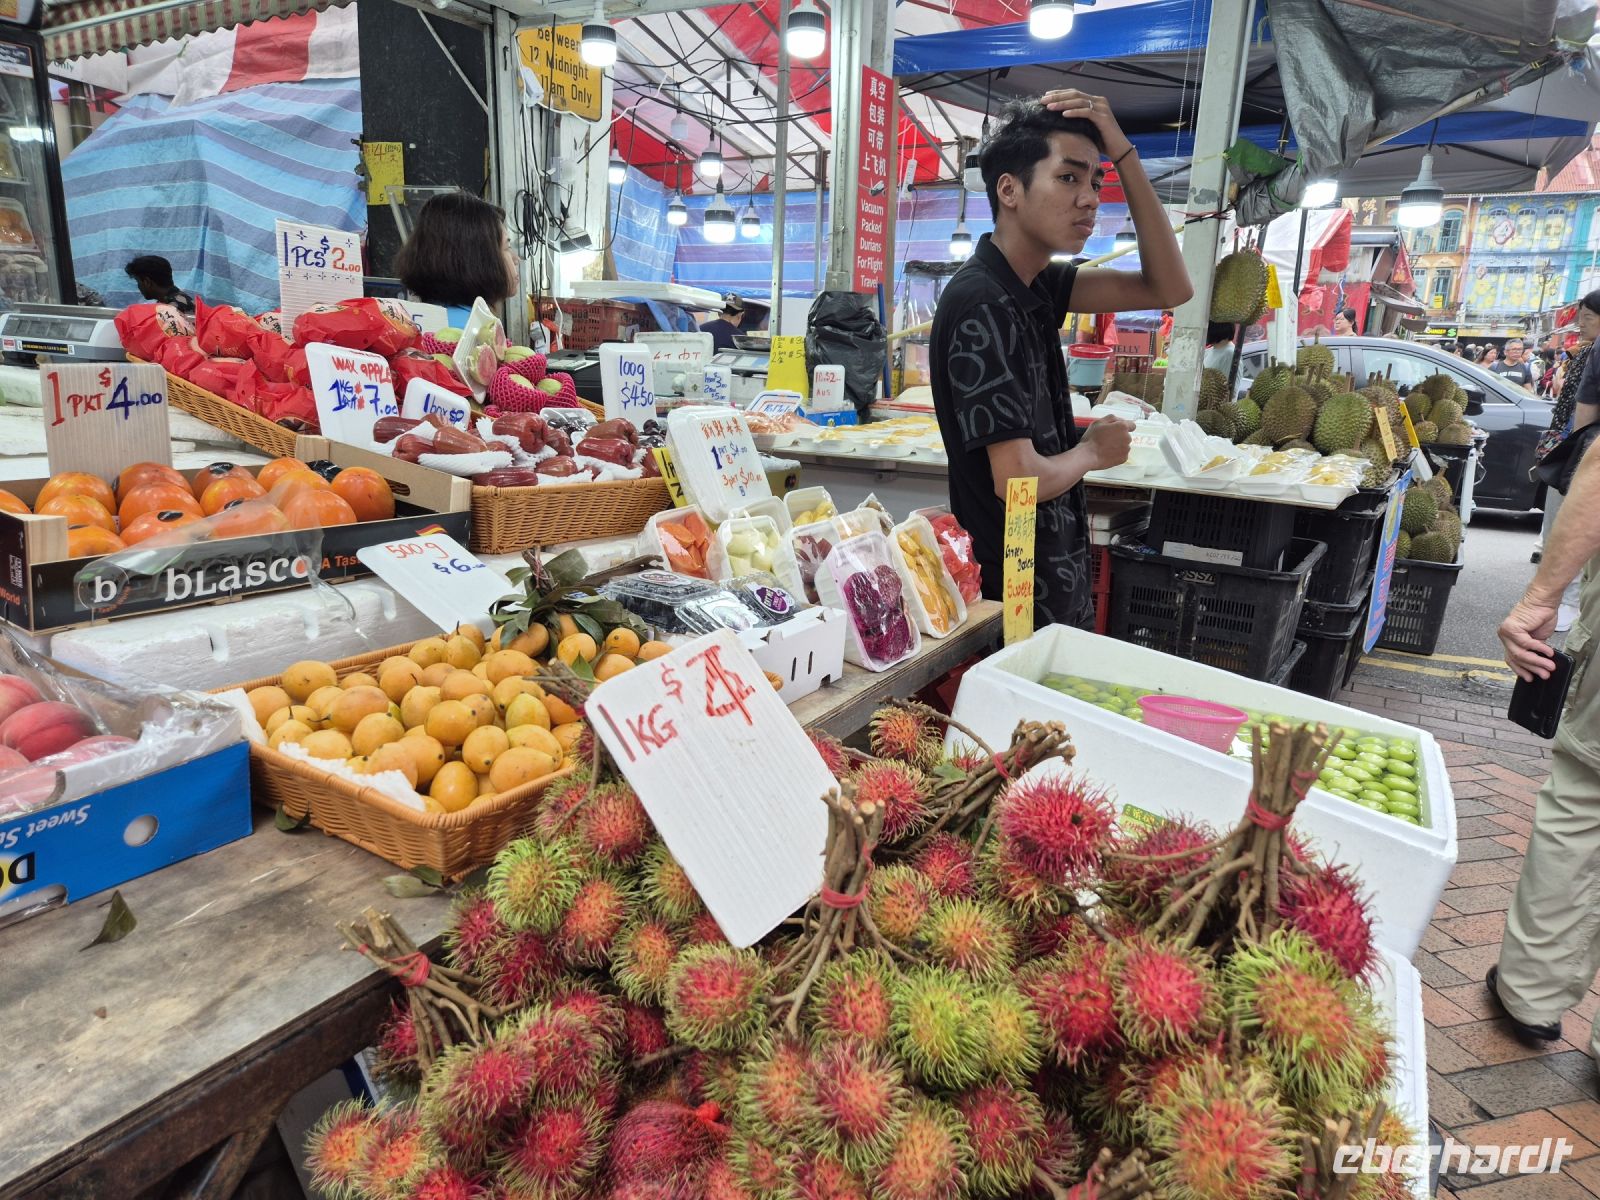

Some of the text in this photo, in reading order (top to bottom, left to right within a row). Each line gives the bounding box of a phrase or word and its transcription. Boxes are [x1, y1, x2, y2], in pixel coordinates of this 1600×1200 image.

[571, 84, 593, 108] Only
[870, 77, 887, 101] 真空
[869, 101, 885, 127] 包装
[868, 128, 884, 151] 可带
[862, 152, 887, 177] 上飞机
[861, 198, 884, 216] Vacuum
[861, 218, 882, 234] Packed
[860, 237, 882, 252] Durians
[860, 275, 879, 288] Travel
[332, 356, 358, 375] WAX
[335, 554, 361, 567] Tas
[26, 803, 91, 838] Sweet
